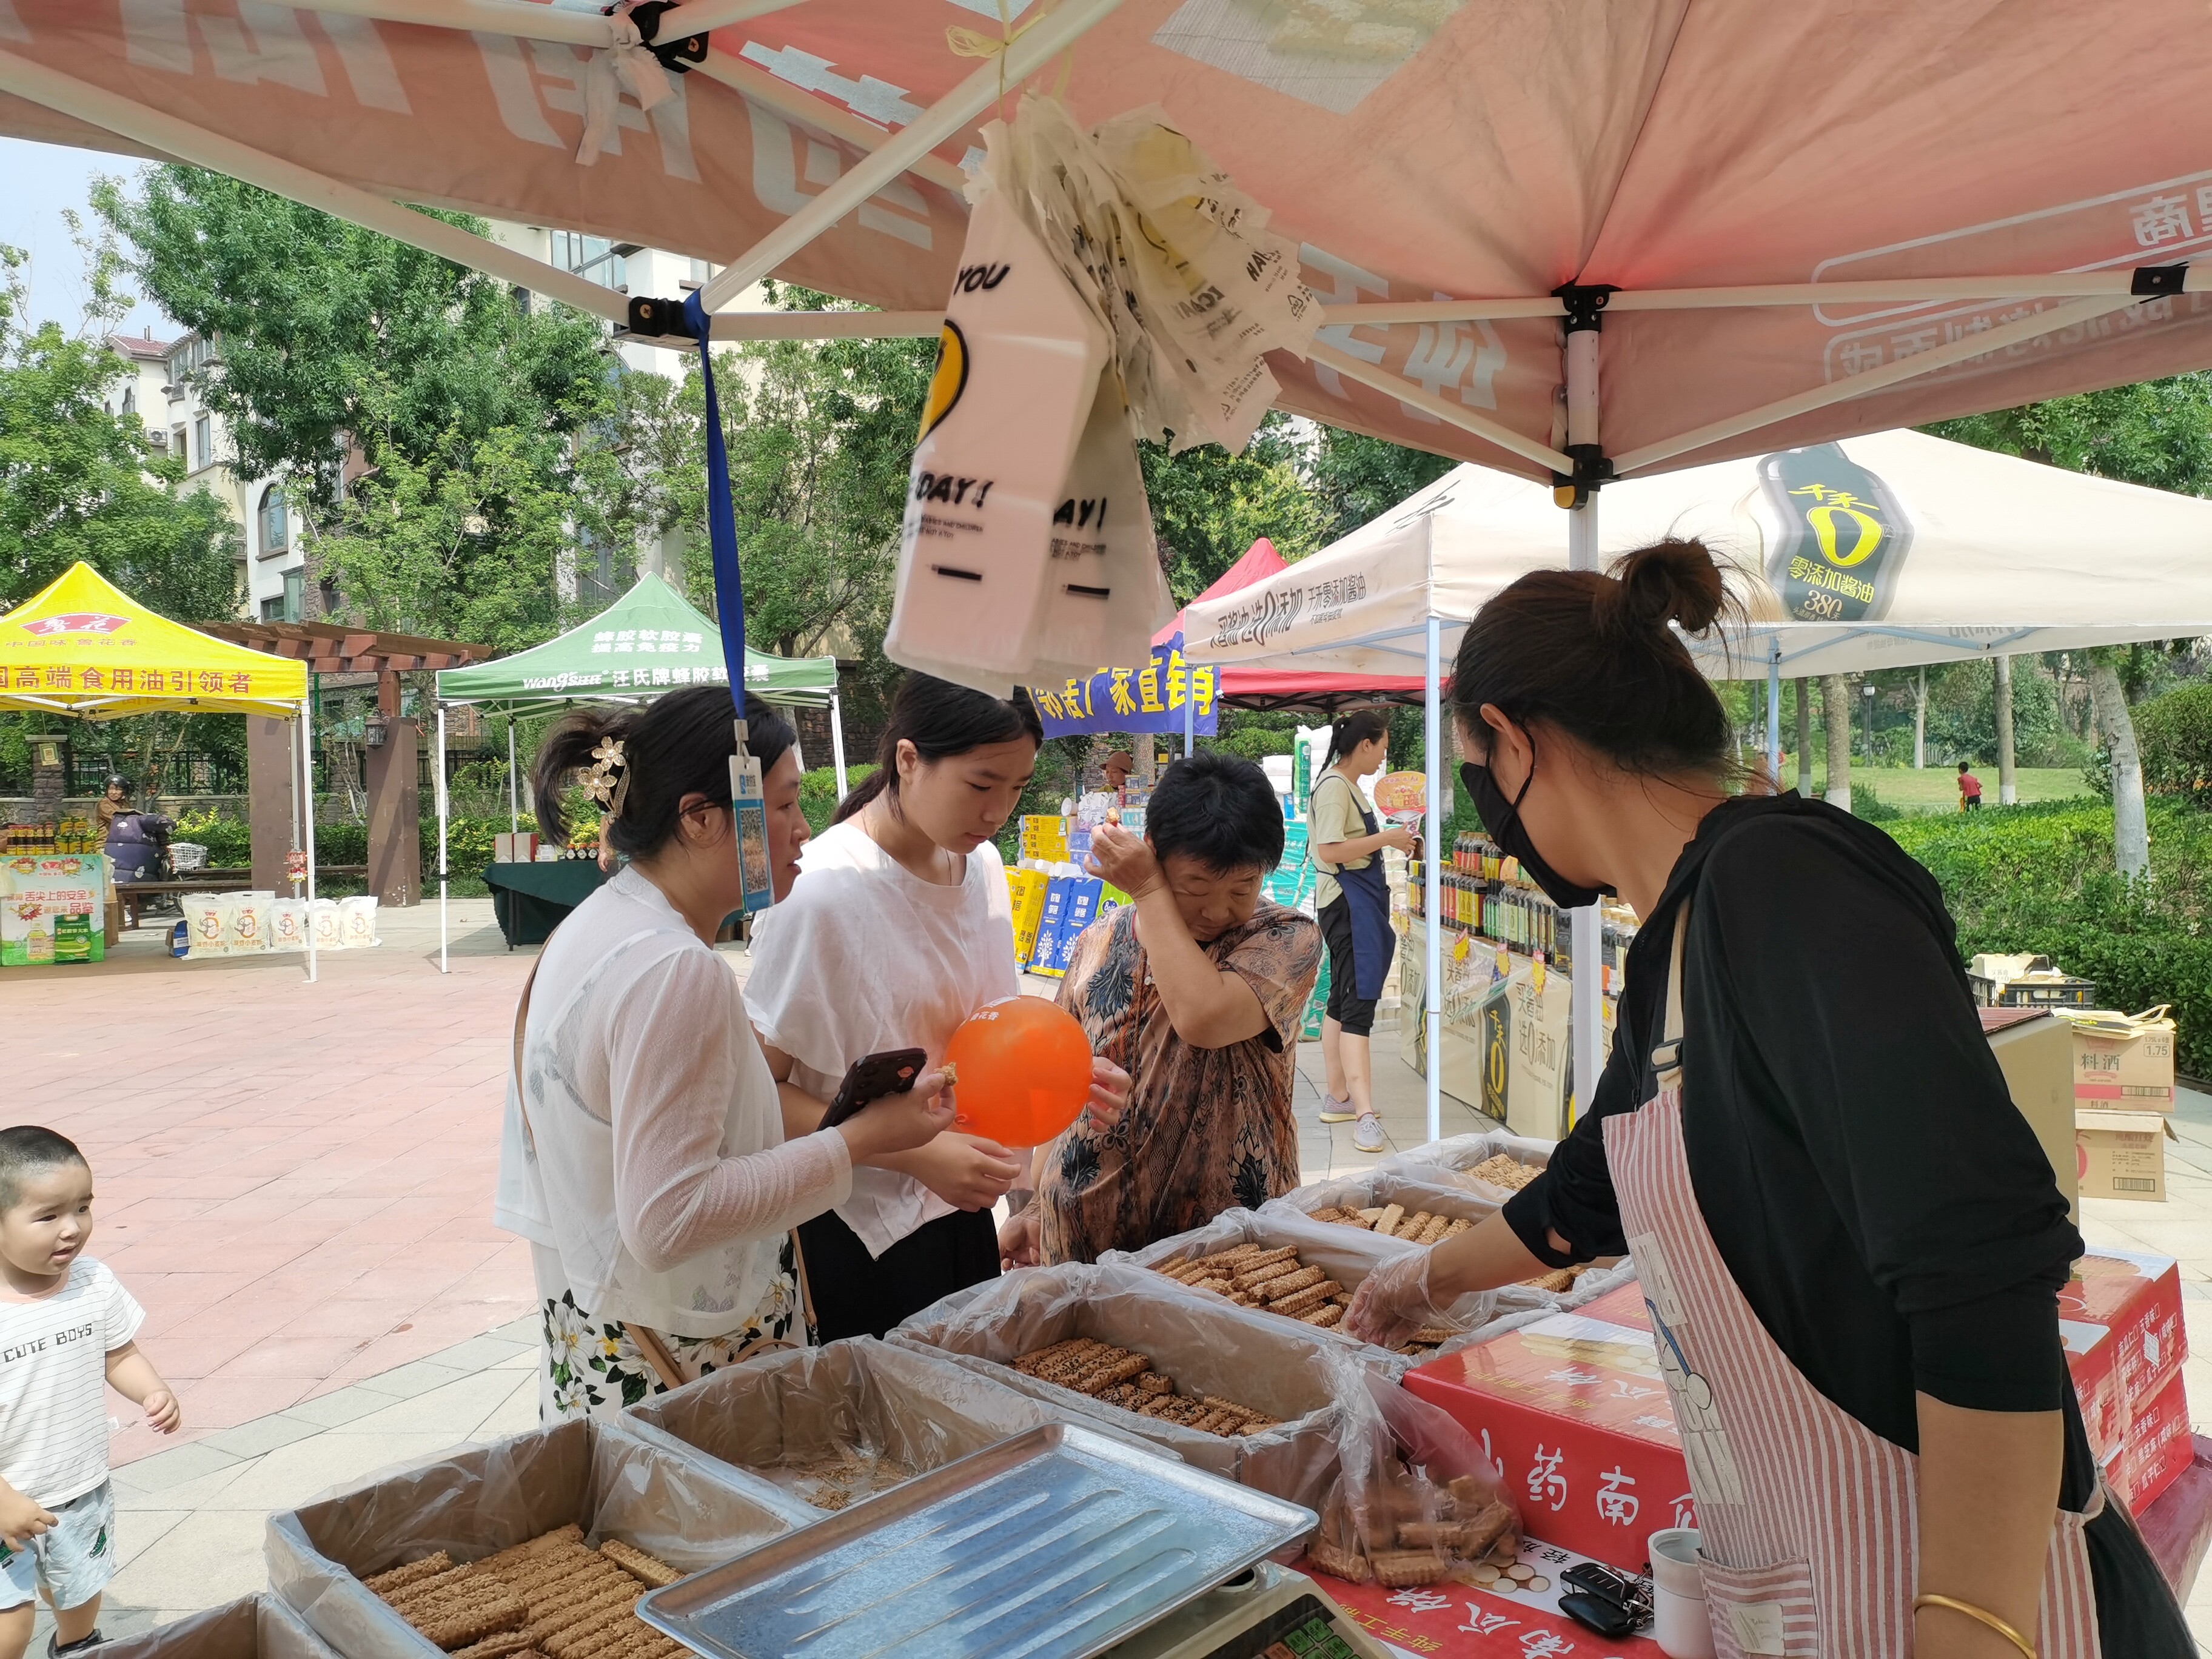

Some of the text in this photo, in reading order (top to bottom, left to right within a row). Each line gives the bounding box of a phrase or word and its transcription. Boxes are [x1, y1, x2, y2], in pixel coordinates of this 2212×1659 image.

[954, 264, 1010, 296] YOU
[1788, 483, 1879, 510] 千禾
[1788, 555, 1875, 603] 零添加酱油
[591, 642, 702, 653] 提高免疫力
[25, 890, 87, 902] 舌尖上的安全
[2146, 1045, 2168, 1056] 1.75
[2080, 1053, 2121, 1071] 料酒
[4, 1322, 93, 1363] CUTE BOYS
